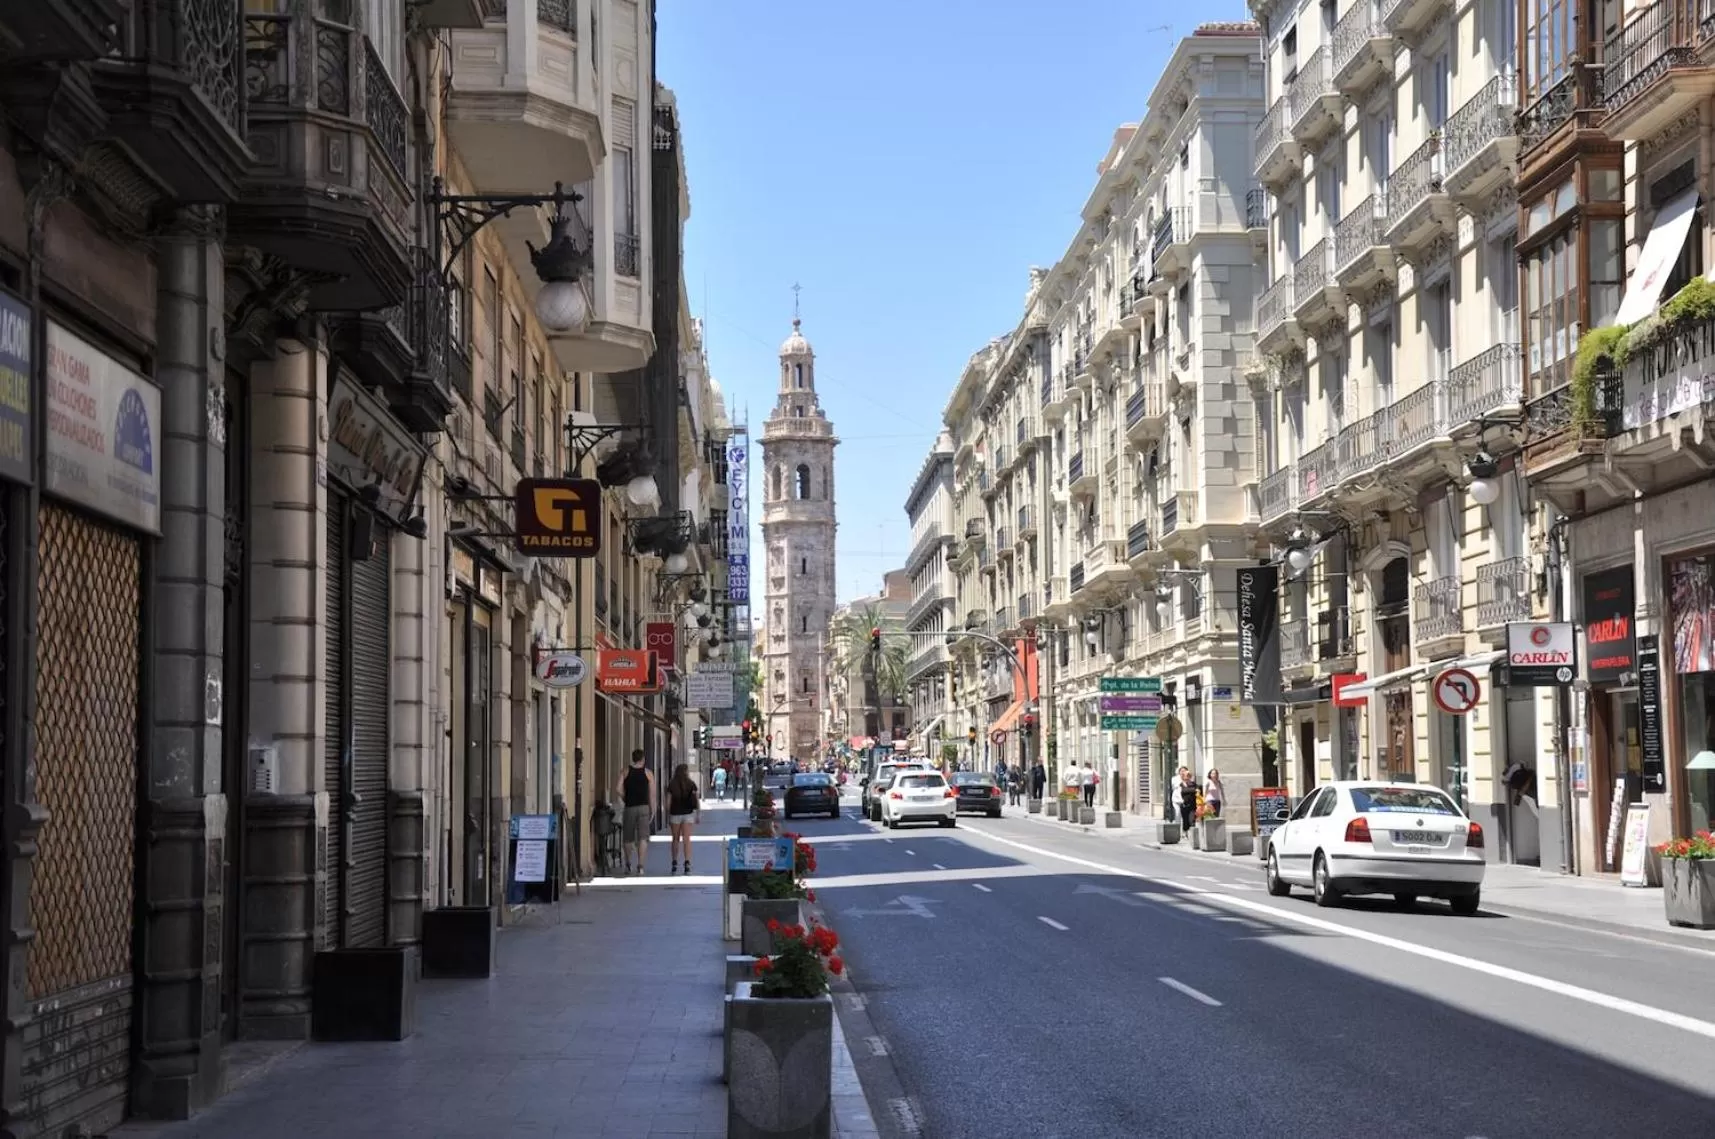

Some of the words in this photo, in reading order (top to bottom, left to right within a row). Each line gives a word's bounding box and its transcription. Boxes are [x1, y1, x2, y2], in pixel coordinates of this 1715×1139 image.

[521, 535, 594, 547] TABACOS
[1241, 573, 1256, 617] Dehesa
[1241, 620, 1255, 658] Santa
